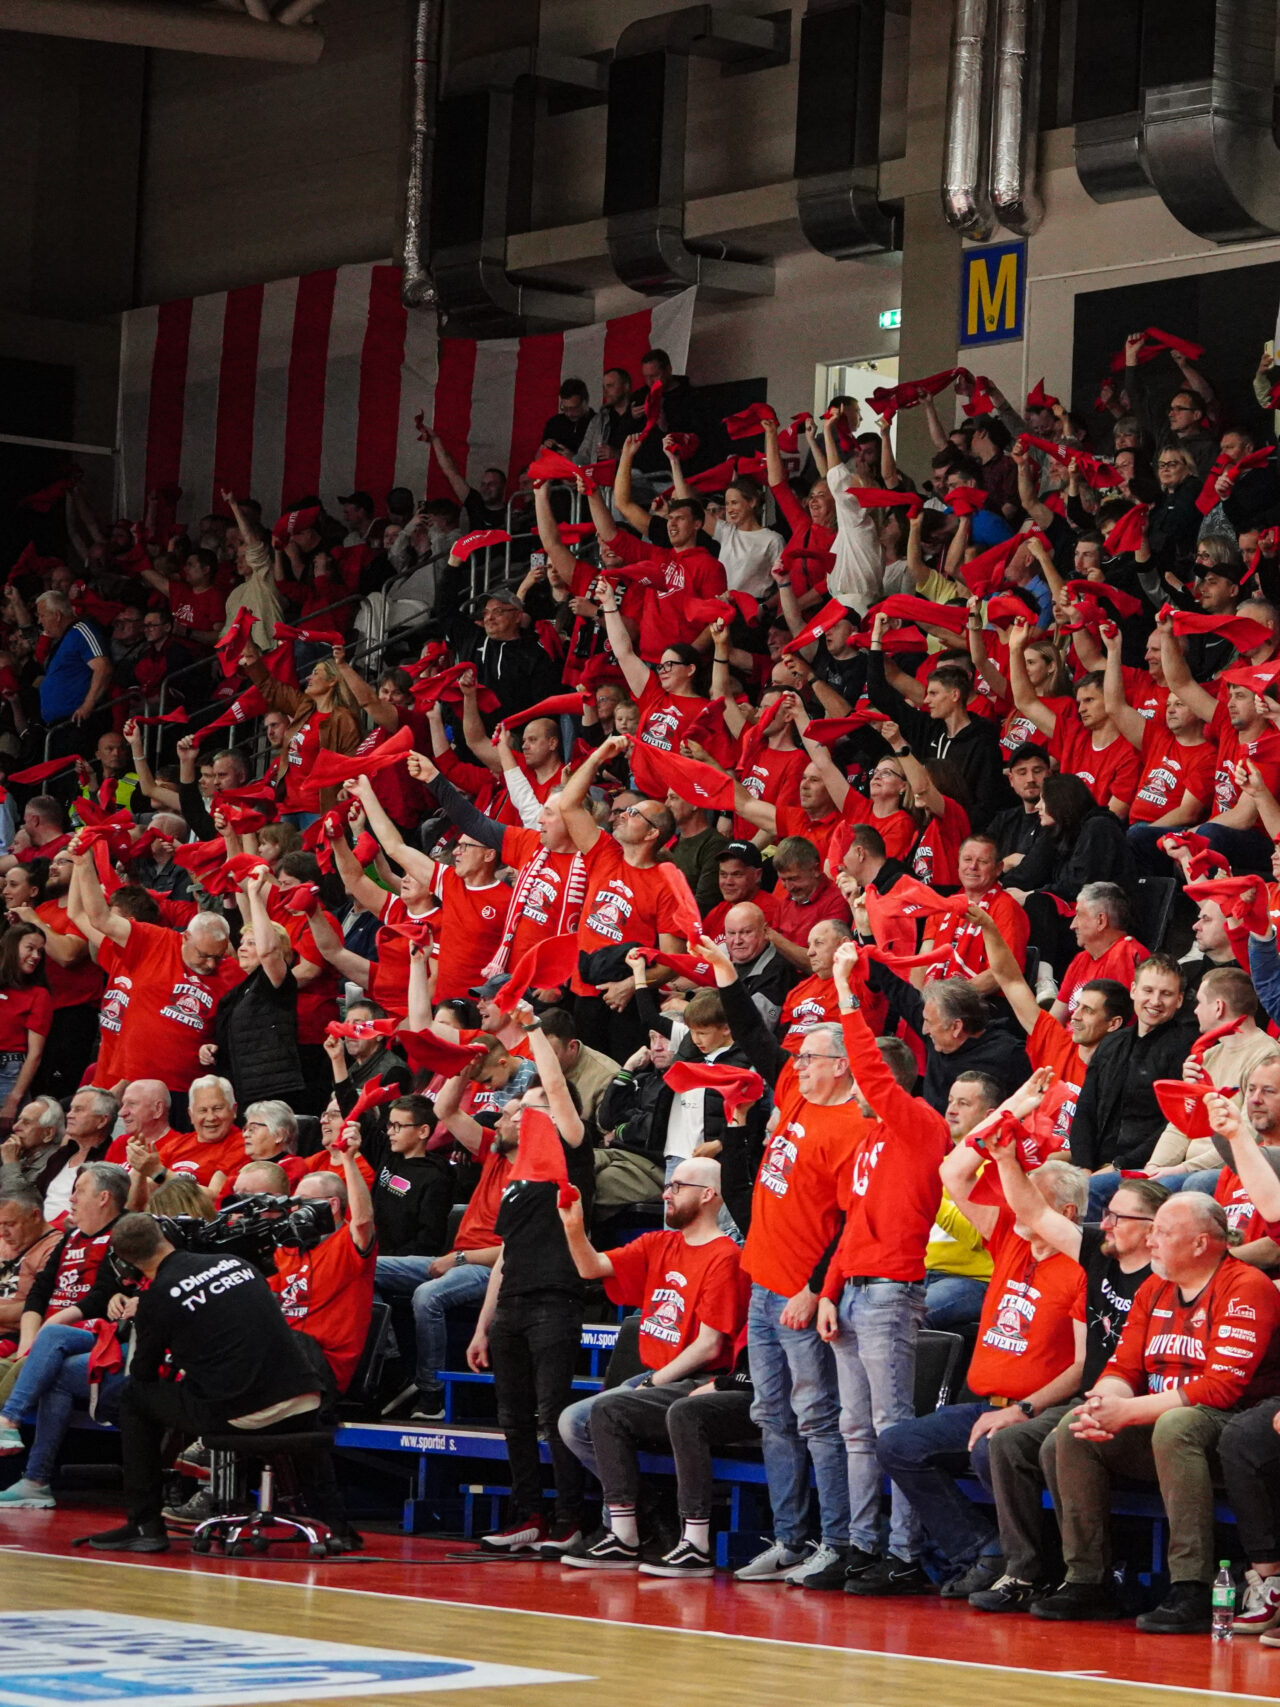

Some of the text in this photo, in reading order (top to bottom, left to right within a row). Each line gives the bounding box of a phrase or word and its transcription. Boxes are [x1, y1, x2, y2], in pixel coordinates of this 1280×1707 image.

[967, 252, 1017, 337] M
[594, 890, 633, 918] UTENOS
[173, 983, 213, 1009] UTENOS
[159, 1005, 205, 1030] JUVENTUS
[180, 1258, 242, 1293] Dimedia
[181, 1265, 256, 1313] TV CREW
[651, 1289, 685, 1313] UTENOS
[997, 1294, 1037, 1323] UTENOS
[640, 1320, 683, 1345] JUVENTUS
[982, 1330, 1029, 1352] JUVENTUS
[1143, 1333, 1208, 1361] JUVENTUS
